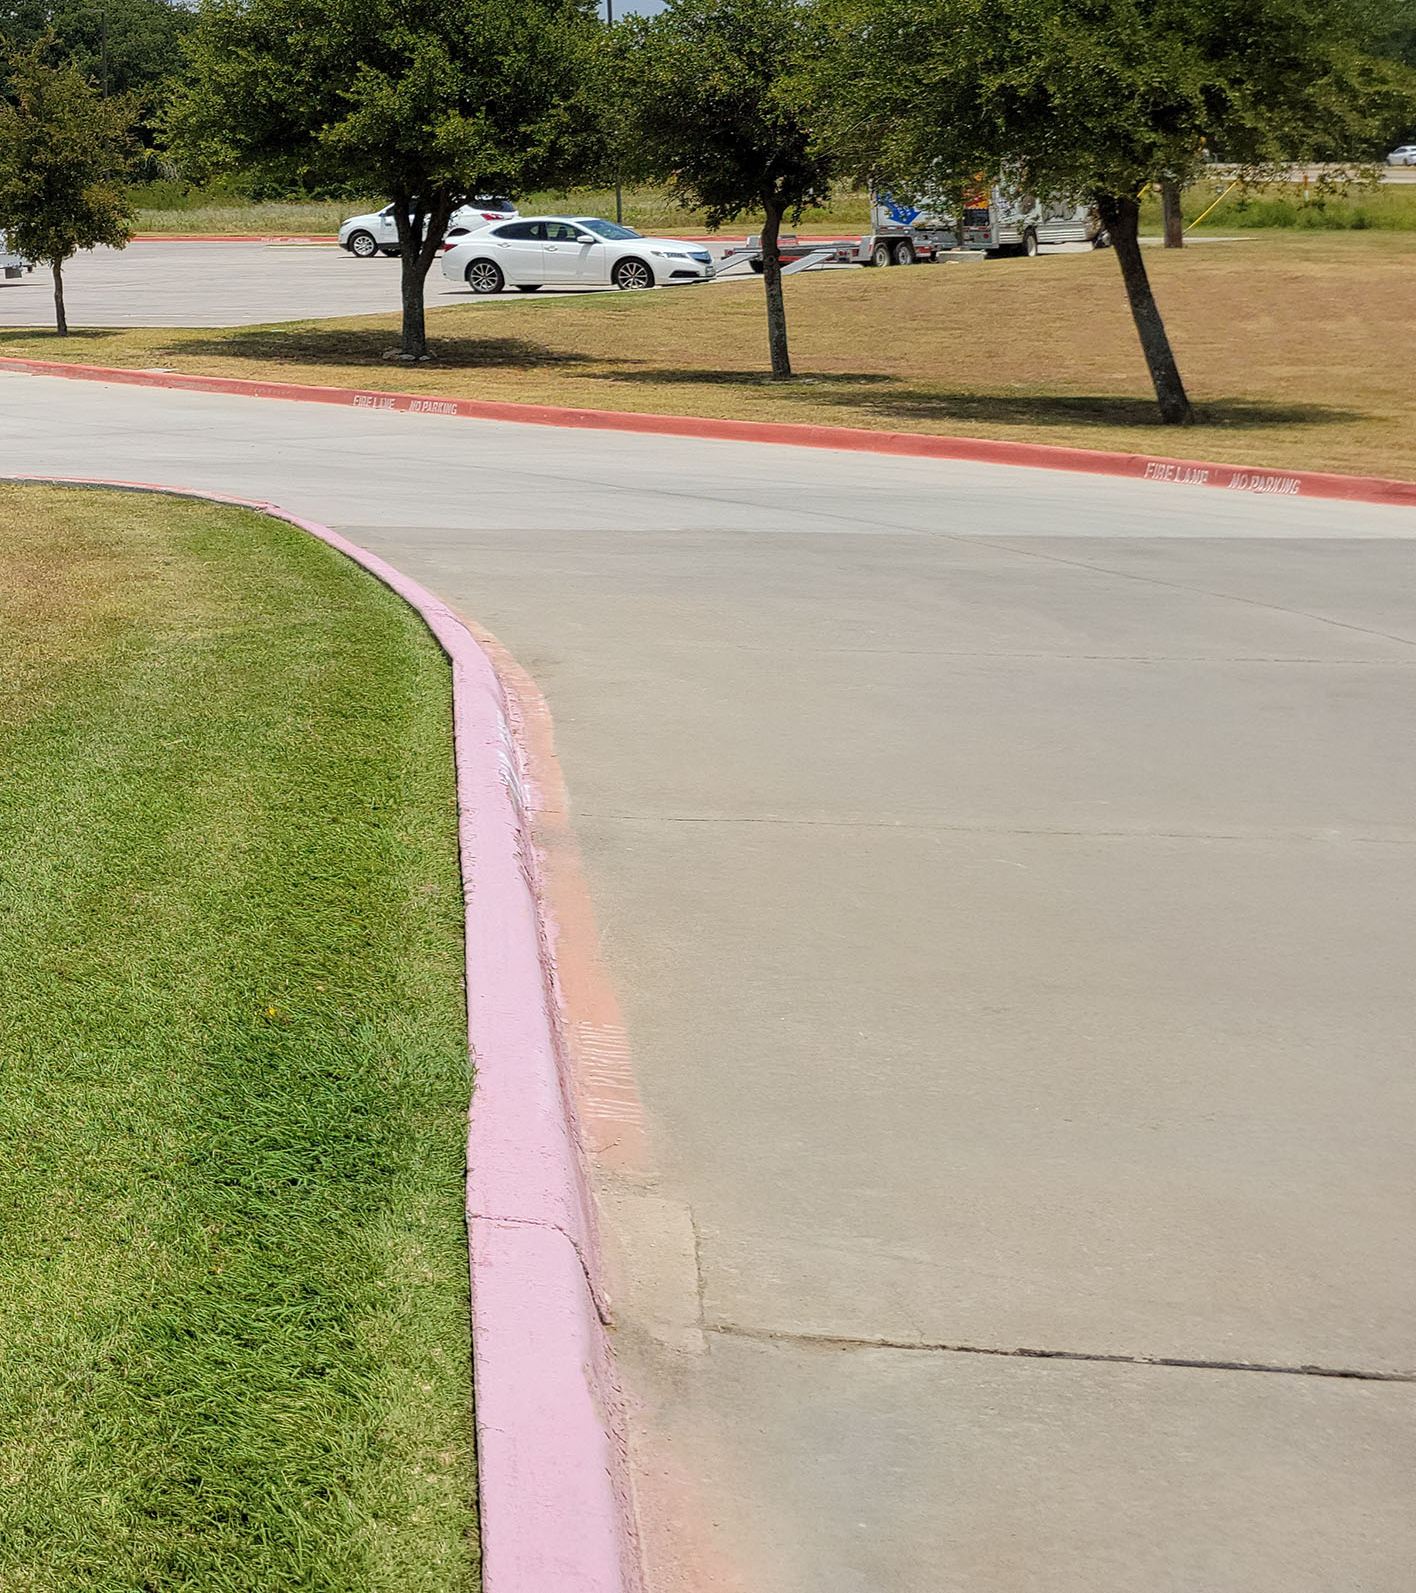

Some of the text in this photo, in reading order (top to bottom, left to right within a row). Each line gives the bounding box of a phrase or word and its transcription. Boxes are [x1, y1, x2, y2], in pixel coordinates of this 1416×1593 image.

[422, 400, 458, 415] PARKING
[1144, 462, 1175, 481] FIRE
[1228, 473, 1249, 490] NO
[1248, 475, 1301, 495] PARKING
